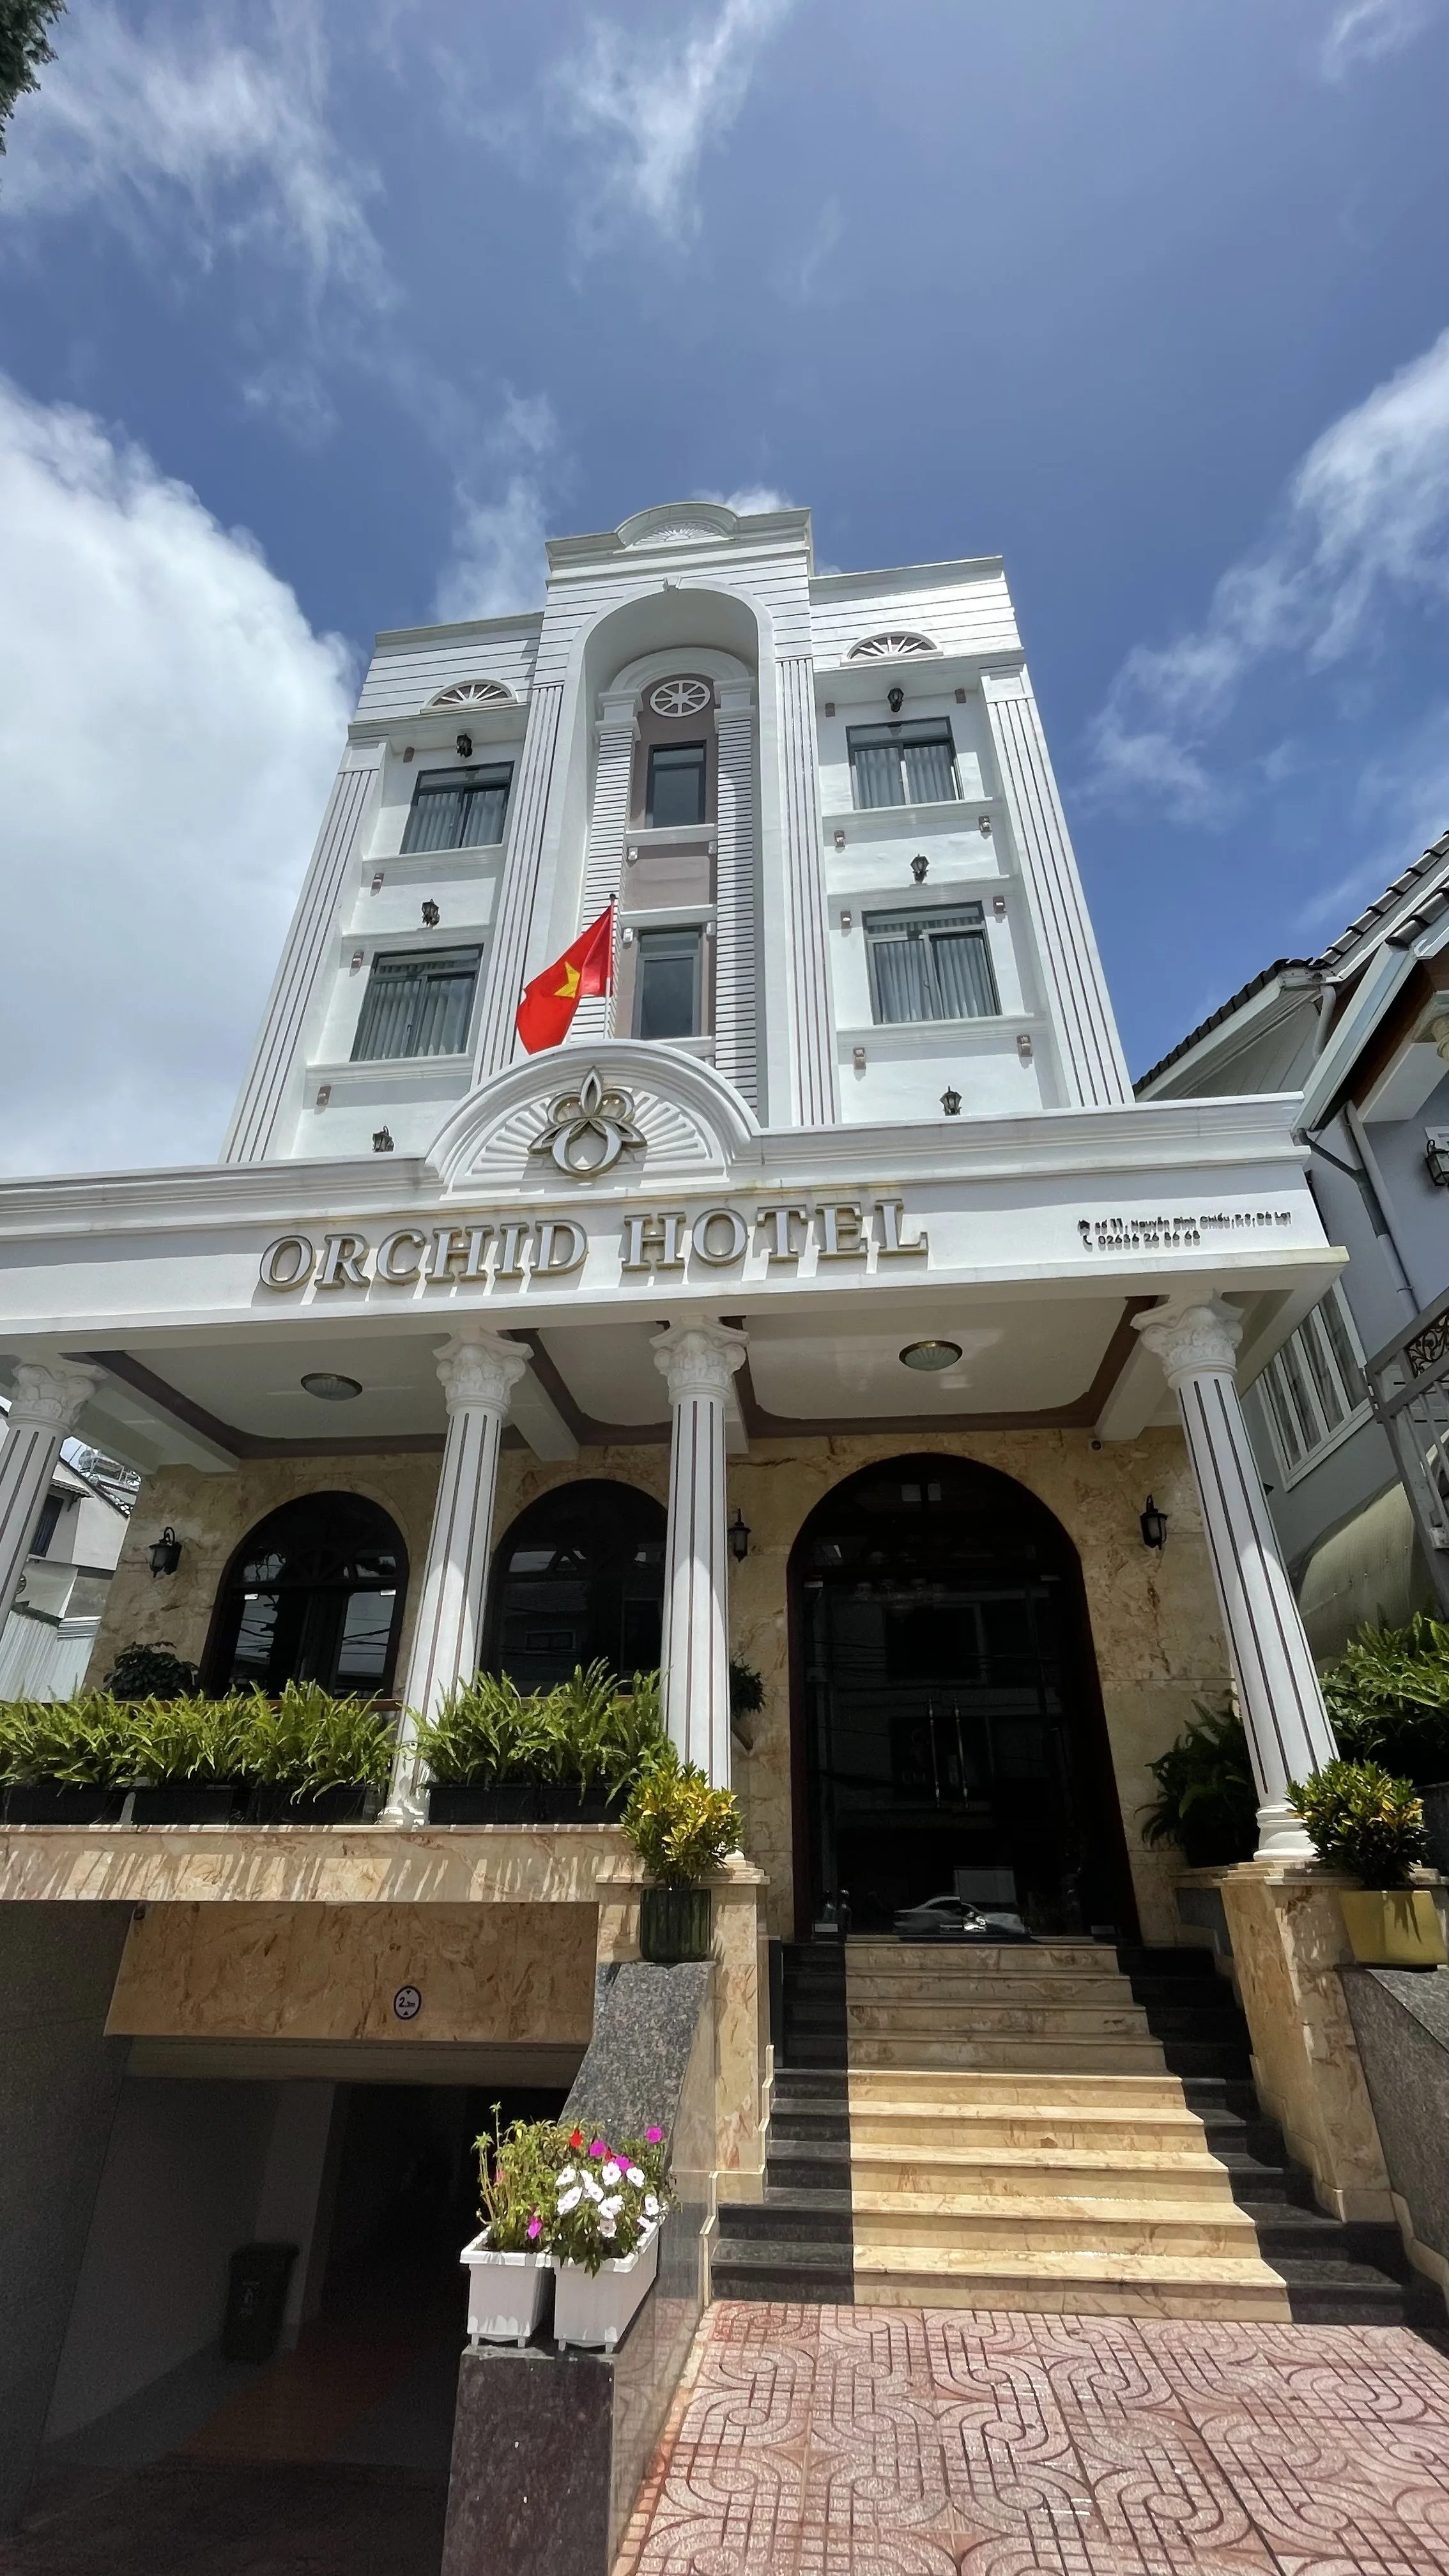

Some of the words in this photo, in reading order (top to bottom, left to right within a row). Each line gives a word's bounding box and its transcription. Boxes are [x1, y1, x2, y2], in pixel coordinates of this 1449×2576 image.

[259, 1219, 588, 1291] ORCHID
[622, 1199, 928, 1273] HOTEL
[1143, 1232, 1160, 1244] 26
